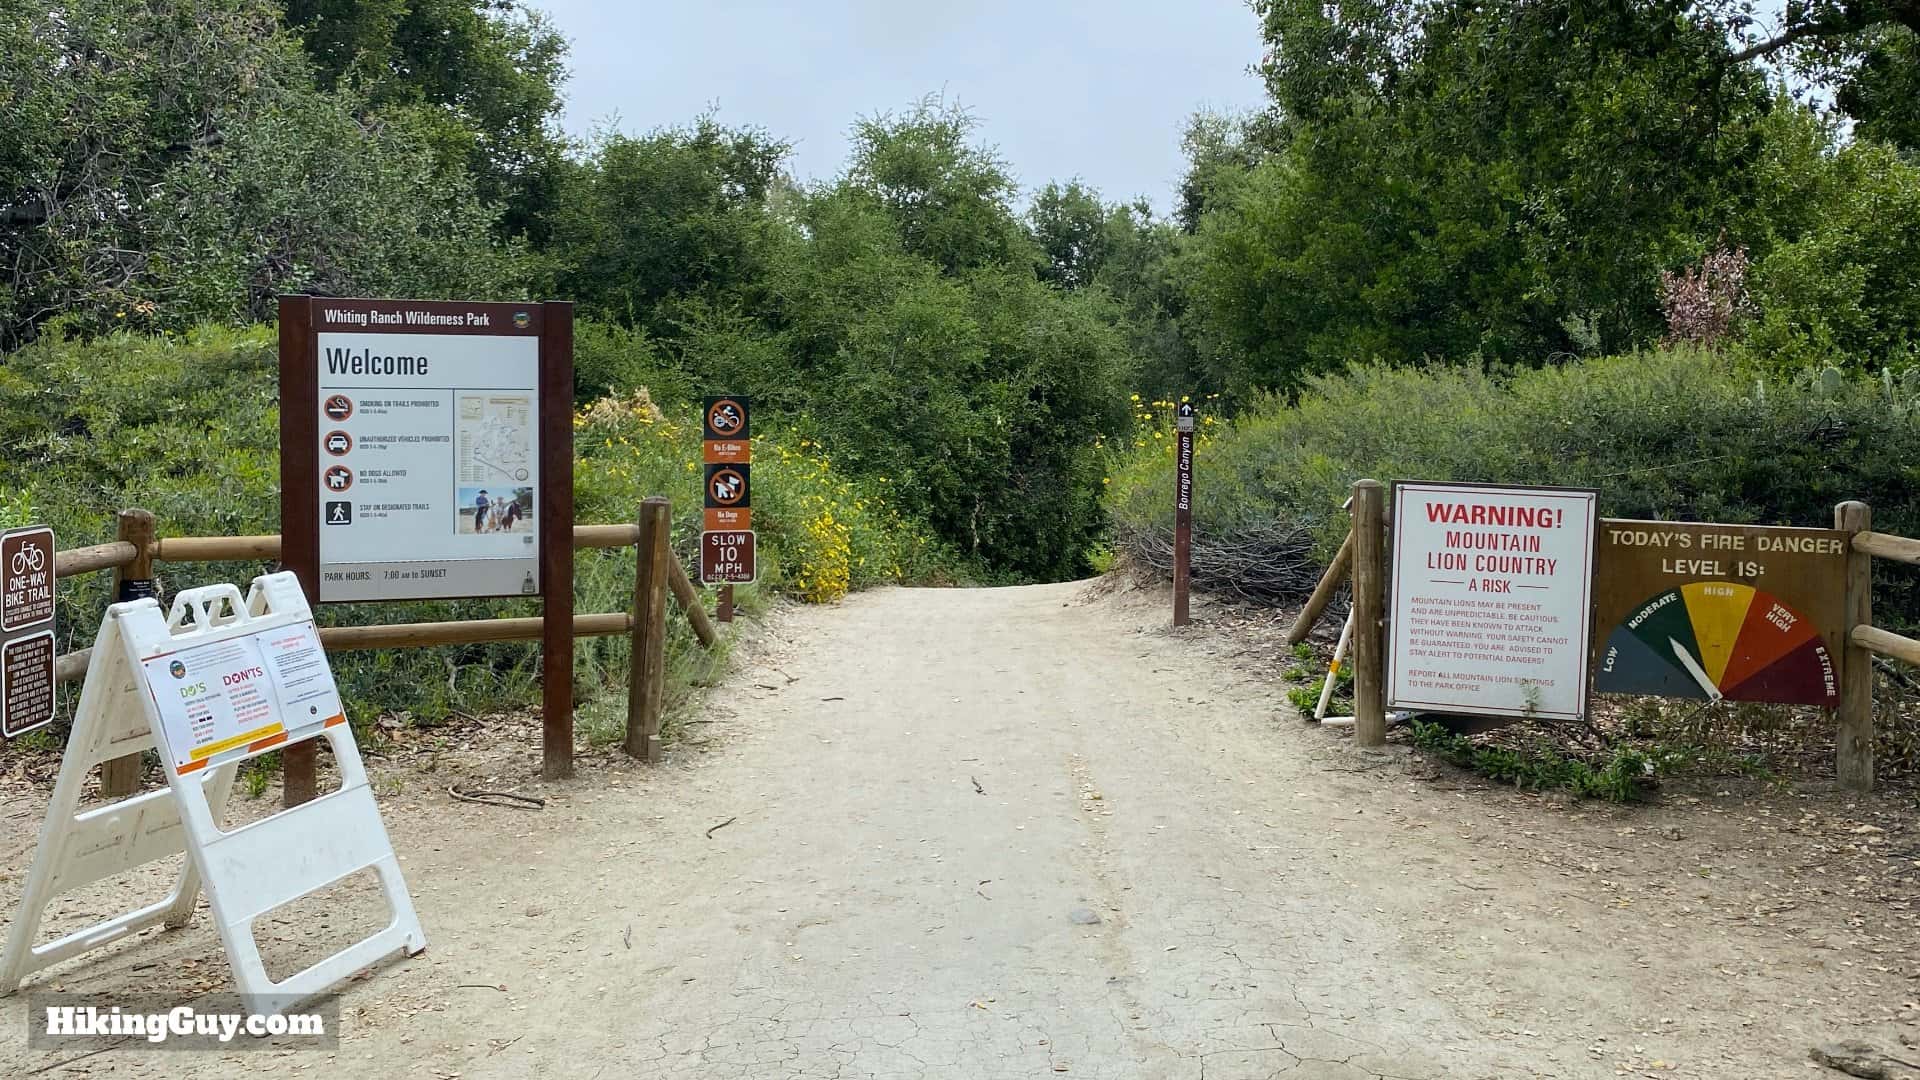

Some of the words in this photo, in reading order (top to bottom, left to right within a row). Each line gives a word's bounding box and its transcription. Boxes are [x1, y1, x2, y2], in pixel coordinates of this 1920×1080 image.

[325, 309, 367, 326] Whiting
[371, 310, 402, 325] Ranch
[406, 311, 464, 326] Wilderness
[467, 312, 490, 326] Park
[326, 348, 429, 375] Welcome
[1179, 436, 1192, 471] Canyon
[1178, 472, 1191, 510] Borrego
[1426, 502, 1563, 529] WARNING!
[711, 534, 745, 546] SLOW
[1446, 531, 1541, 553] MOUNTAIN
[1609, 530, 1692, 549] TODAY'S
[1701, 533, 1745, 551] FIRE
[1757, 536, 1843, 555] DANGER
[720, 546, 737, 562] 10
[715, 563, 742, 574] MPH
[1427, 552, 1467, 571] LION
[1475, 554, 1557, 576] COUNTRY
[1662, 559, 1726, 576] LEVEL
[1738, 561, 1766, 578] IS:
[9, 571, 47, 592] ONE-WAY
[324, 572, 344, 582] PARK
[420, 568, 447, 578] SUNSET
[1469, 578, 1478, 592] A
[1482, 579, 1511, 594] RISK
[1703, 586, 1735, 597] HIGH
[5, 591, 25, 608] BIKE
[28, 586, 51, 602] TRAIL
[1411, 597, 1452, 606] MOUNTAIN
[1453, 599, 1476, 608] LIONS
[1477, 601, 1494, 609] MAY
[1507, 602, 1542, 611] PRESENT
[1411, 607, 1427, 615] AND
[1428, 608, 1444, 616] ARE
[1508, 613, 1518, 621] BE
[1628, 592, 1678, 630] MODERATE
[1771, 603, 1799, 625] VERY
[1411, 617, 1429, 625] THEY
[1430, 619, 1450, 627] HAVE
[1451, 620, 1471, 628] BEEN
[1472, 622, 1503, 630] KNOWN
[1504, 623, 1514, 631] TO
[1515, 624, 1544, 633] ATTACK
[1765, 611, 1791, 633] HIGH
[1410, 628, 1445, 637] WITHOUT
[1486, 633, 1506, 641] YOUR
[1507, 634, 1536, 643] SAFETY
[1536, 636, 1569, 645] CANNOT
[1409, 638, 1420, 646] BE
[1474, 642, 1490, 650] YOU
[1490, 643, 1505, 651] ARE
[1508, 644, 1542, 654] ADVISED
[1543, 647, 1553, 655] TO
[1409, 648, 1427, 656] STAY
[1428, 649, 1451, 658] ALERT
[1451, 651, 1462, 659] TO
[1463, 652, 1505, 662] POTENTIAL
[1603, 646, 1619, 673] LOW
[222, 666, 264, 686] DON'TS
[1408, 669, 1437, 678] REPORT
[1438, 671, 1451, 679] ALL
[1452, 672, 1494, 682] MOUNTAIN
[1495, 675, 1513, 684] LION
[1815, 646, 1836, 697] EXTREME
[1408, 679, 1418, 687] TO
[1419, 680, 1433, 688] THE
[1434, 682, 1455, 690] PARK
[1455, 683, 1481, 692] OFFICE
